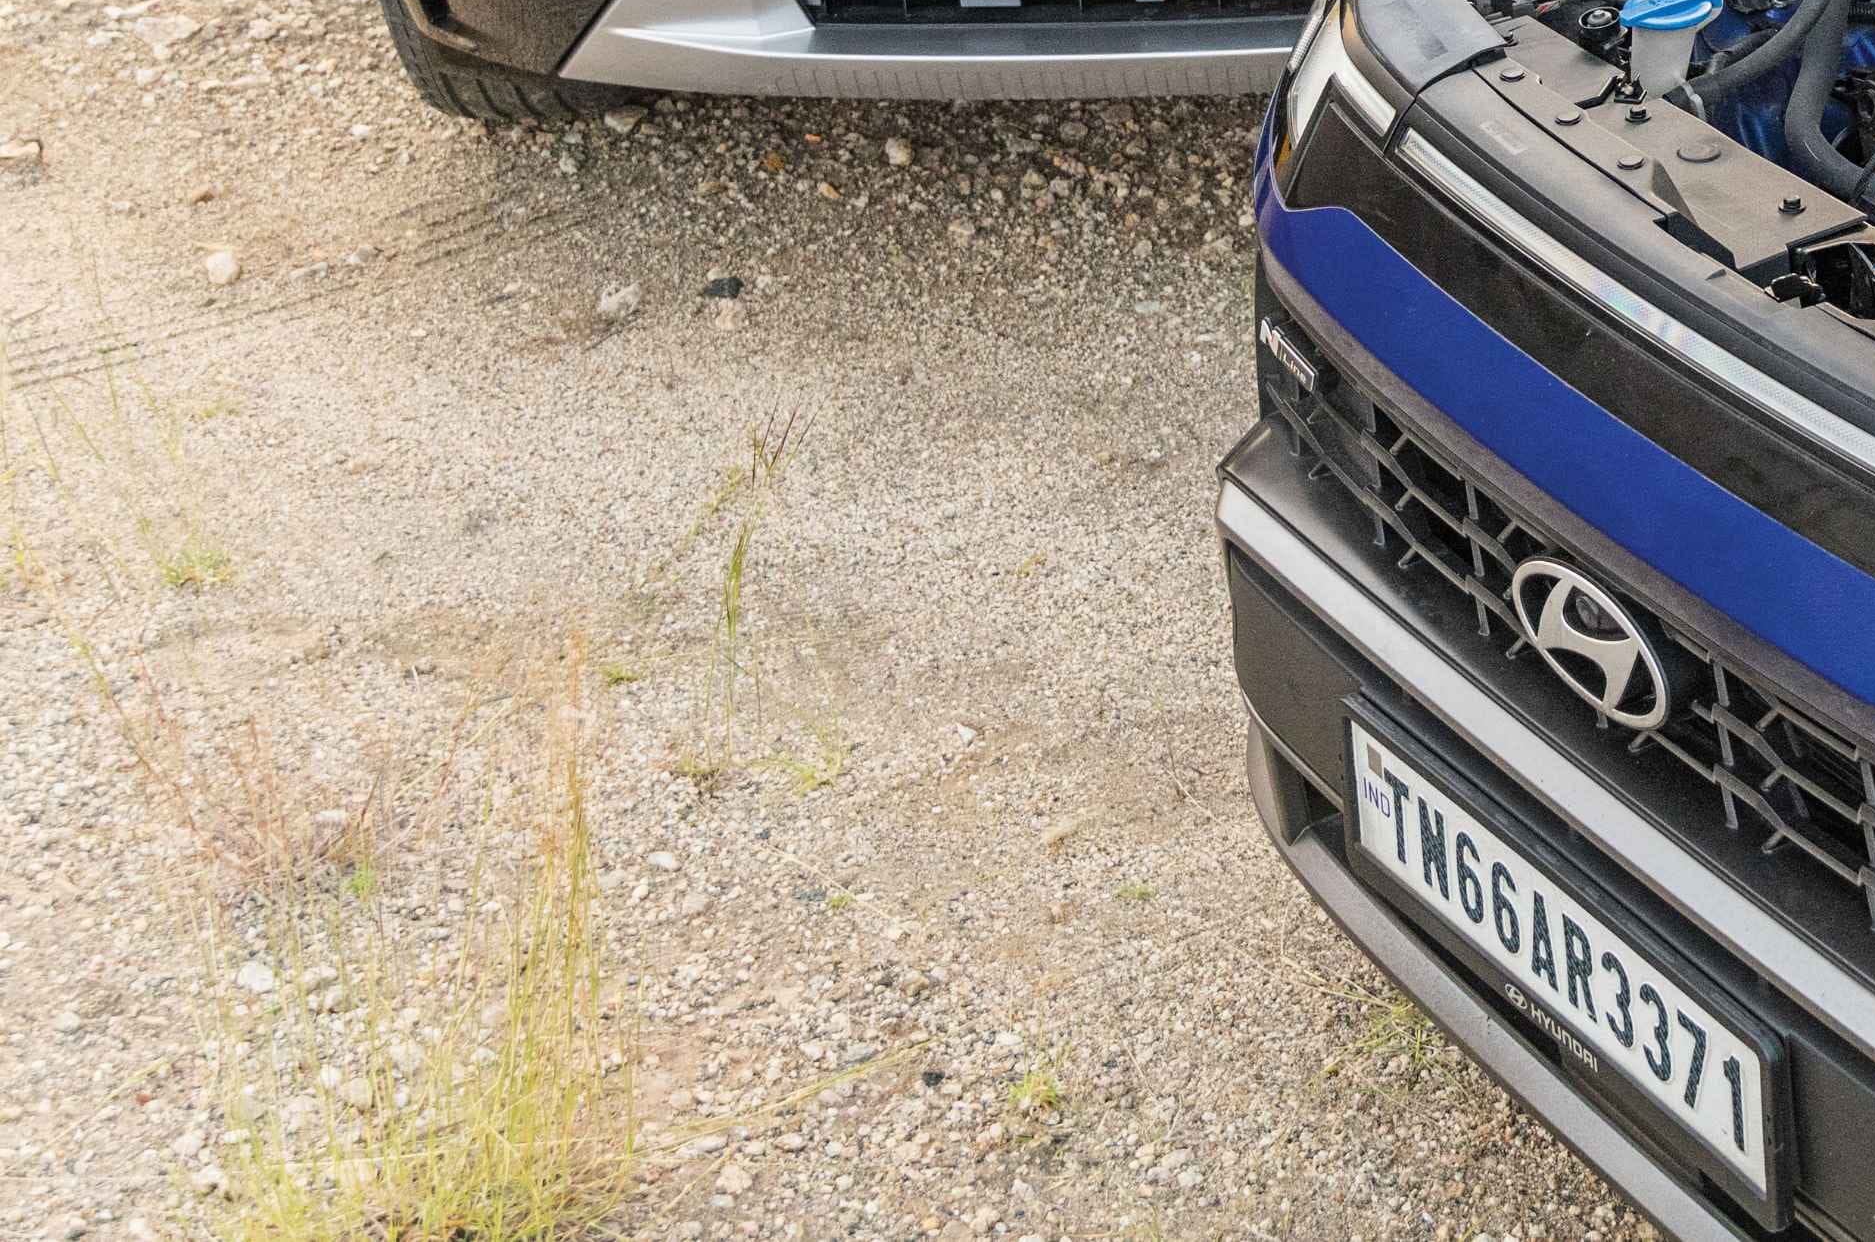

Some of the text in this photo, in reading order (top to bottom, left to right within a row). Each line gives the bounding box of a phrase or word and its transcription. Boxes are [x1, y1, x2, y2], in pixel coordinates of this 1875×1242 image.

[1363, 776, 1391, 817] IND
[1383, 767, 1746, 1152] TN66AR3371
[1530, 1002, 1599, 1074] HYUNDAI
